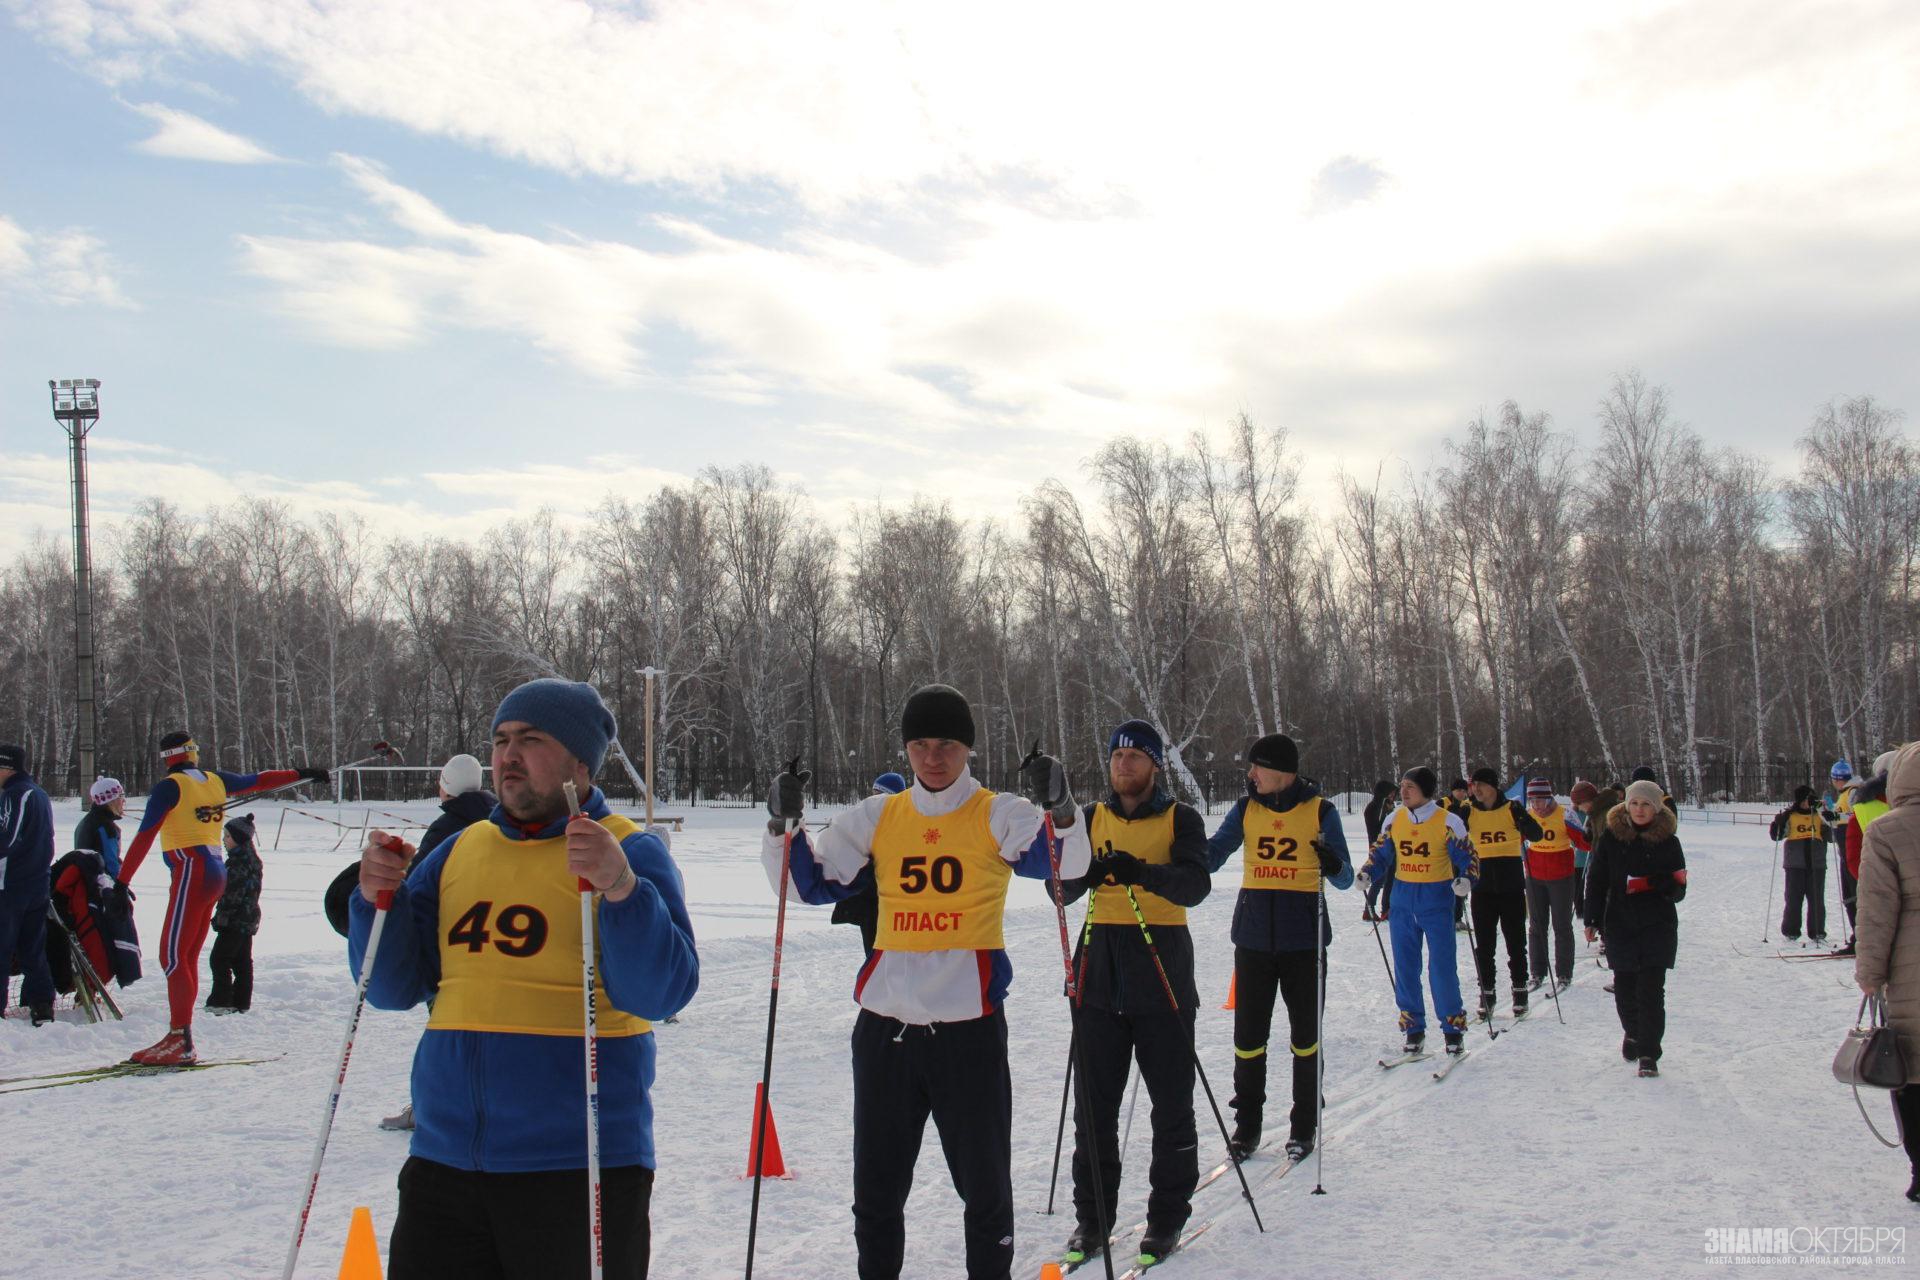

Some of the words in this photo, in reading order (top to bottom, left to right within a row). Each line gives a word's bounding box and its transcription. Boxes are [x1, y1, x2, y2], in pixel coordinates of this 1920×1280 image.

[1480, 831, 1507, 844] 56
[1544, 829, 1555, 841] 0
[1256, 836, 1298, 862] 52
[1400, 840, 1431, 858] 54
[900, 855, 964, 895] 50
[1253, 866, 1298, 880] ПЛАСТ
[448, 900, 549, 958] 49
[893, 911, 964, 932] ПЛАСТ
